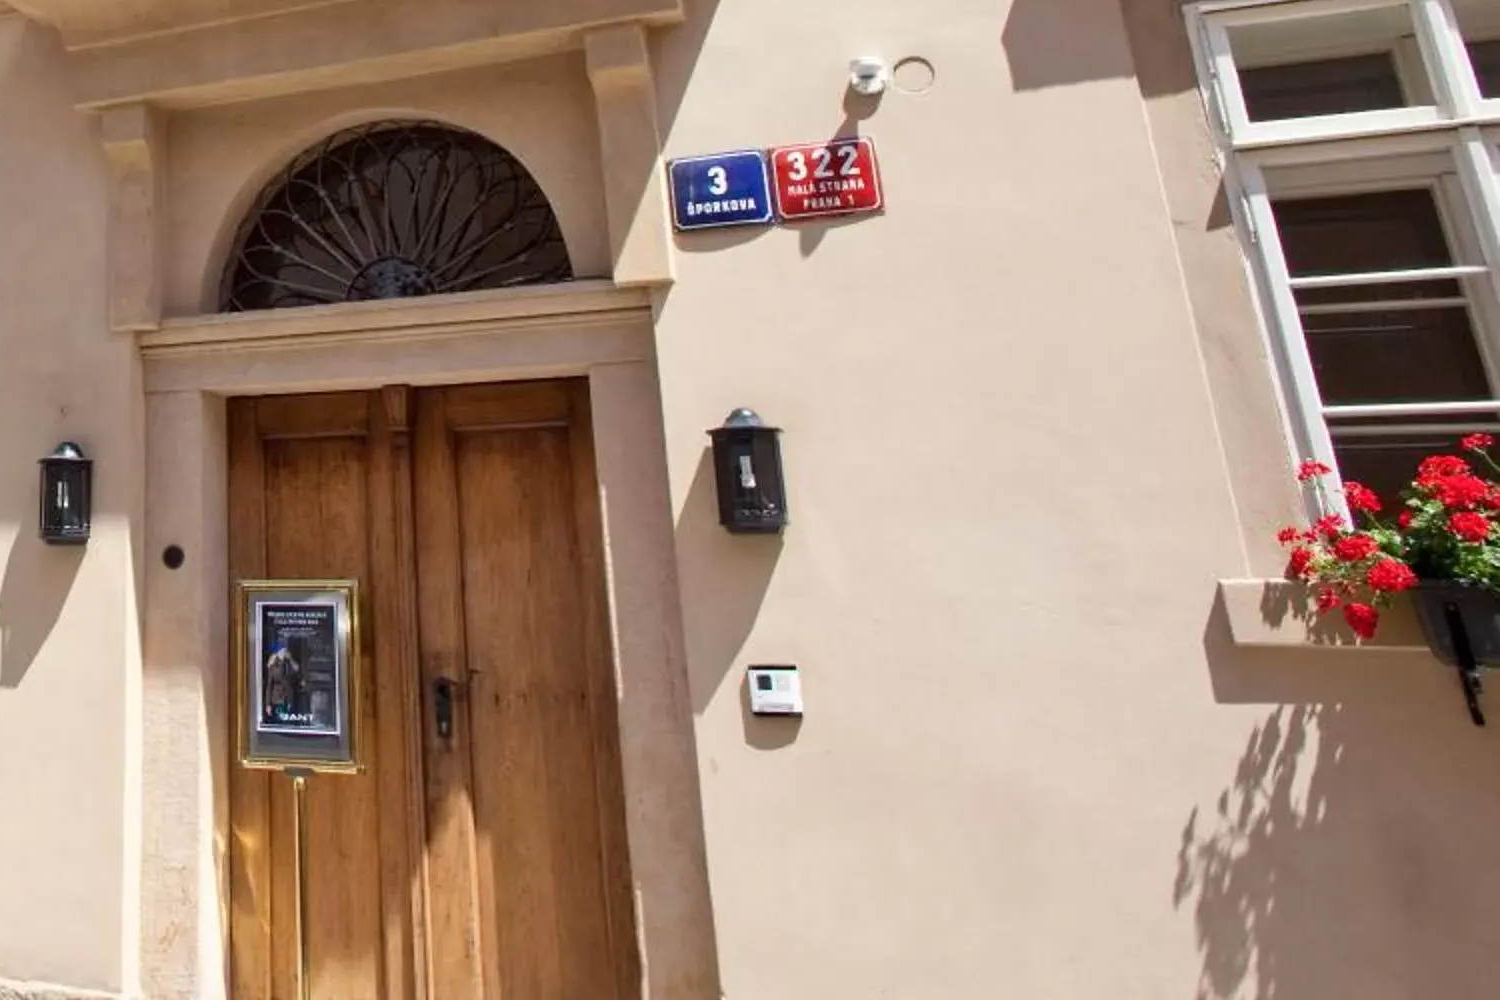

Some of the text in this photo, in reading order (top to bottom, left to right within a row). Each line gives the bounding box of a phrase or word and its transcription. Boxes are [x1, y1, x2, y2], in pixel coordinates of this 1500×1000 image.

[787, 144, 861, 181] 322
[706, 164, 728, 196] 3
[819, 178, 865, 194] STRANA
[686, 197, 757, 217] ŠPORKOVA
[803, 194, 856, 210] PRAHA 1
